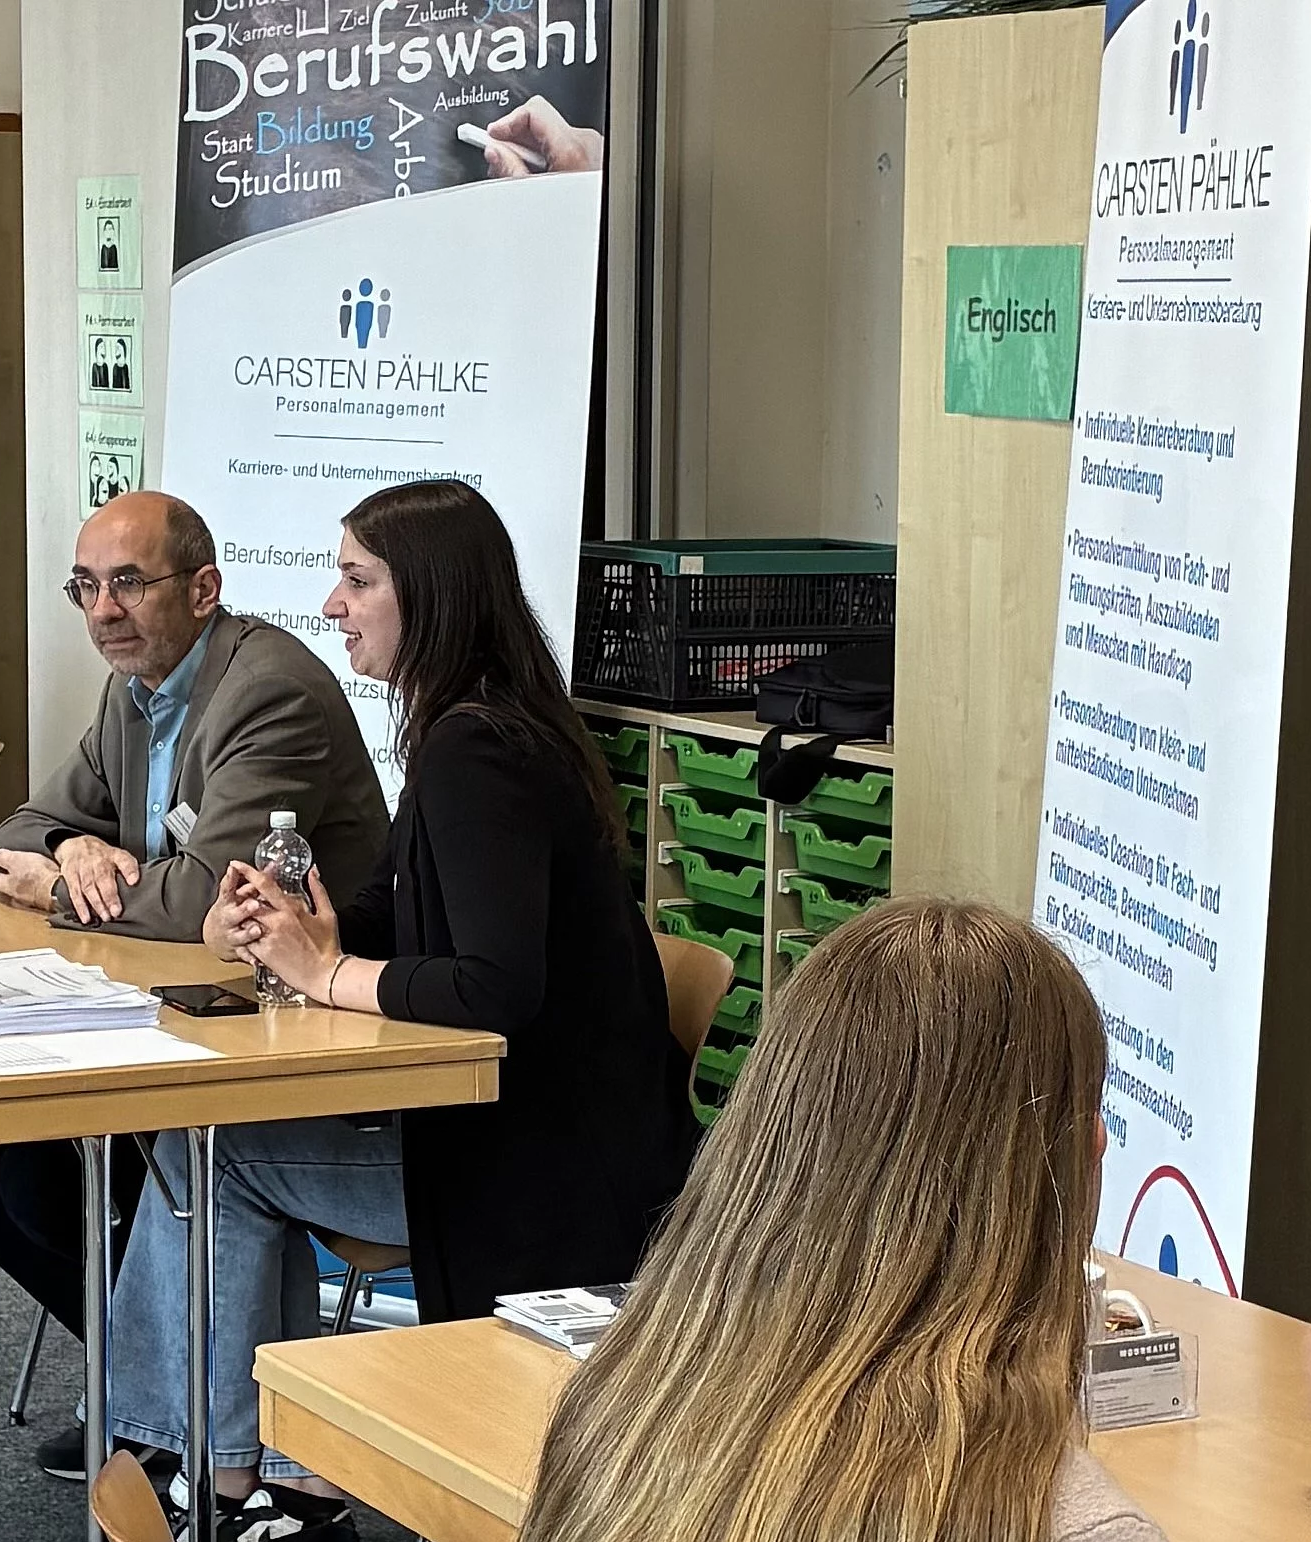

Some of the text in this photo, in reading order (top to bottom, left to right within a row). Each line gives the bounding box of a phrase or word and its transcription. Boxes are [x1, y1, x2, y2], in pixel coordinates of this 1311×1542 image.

[228, 22, 294, 48] Karriere
[339, 5, 370, 32] Ziel
[405, 1, 468, 27] Zukunft
[184, 0, 598, 122] Berufswahl
[432, 86, 510, 113] Ausbildung
[200, 130, 253, 162] Start
[255, 106, 375, 157] Bildung
[211, 154, 341, 209] Studium
[1097, 138, 1274, 218] CARSTEN PÄHLKE
[1119, 232, 1234, 269] Personalmanagement
[968, 297, 1056, 342] Englisch
[1129, 294, 1145, 321] und
[1146, 294, 1262, 331] Unternehmensberatung
[234, 355, 489, 393] CARSTEN PÄHLKE
[275, 396, 445, 421] Personalmanagement
[1084, 410, 1235, 462] Individuelle Karriereberatung und
[228, 458, 288, 477] Karriere-
[293, 462, 317, 478] und
[1081, 455, 1163, 504] Berufsorientierung
[224, 542, 336, 569] Berufsorienti
[1072, 528, 1231, 593] Personalvermittlung von Fach- und
[1145, 593, 1220, 642] Auszubildenden
[1065, 622, 1192, 690] und Menschen mit Handicap
[1059, 690, 1137, 751] Personalberatung
[1139, 725, 1157, 753] von
[1187, 741, 1206, 773] und
[1136, 766, 1199, 821] Unternehmen
[1110, 833, 1154, 887] Coaching
[1155, 853, 1170, 888] für
[1200, 884, 1221, 914] und
[1046, 895, 1060, 928] für
[1096, 928, 1114, 957] und
[1115, 933, 1173, 991] Absolventen
[1121, 887, 1218, 972] Bewerbungstraining
[1145, 1028, 1154, 1061] in
[1156, 1037, 1174, 1074] den
